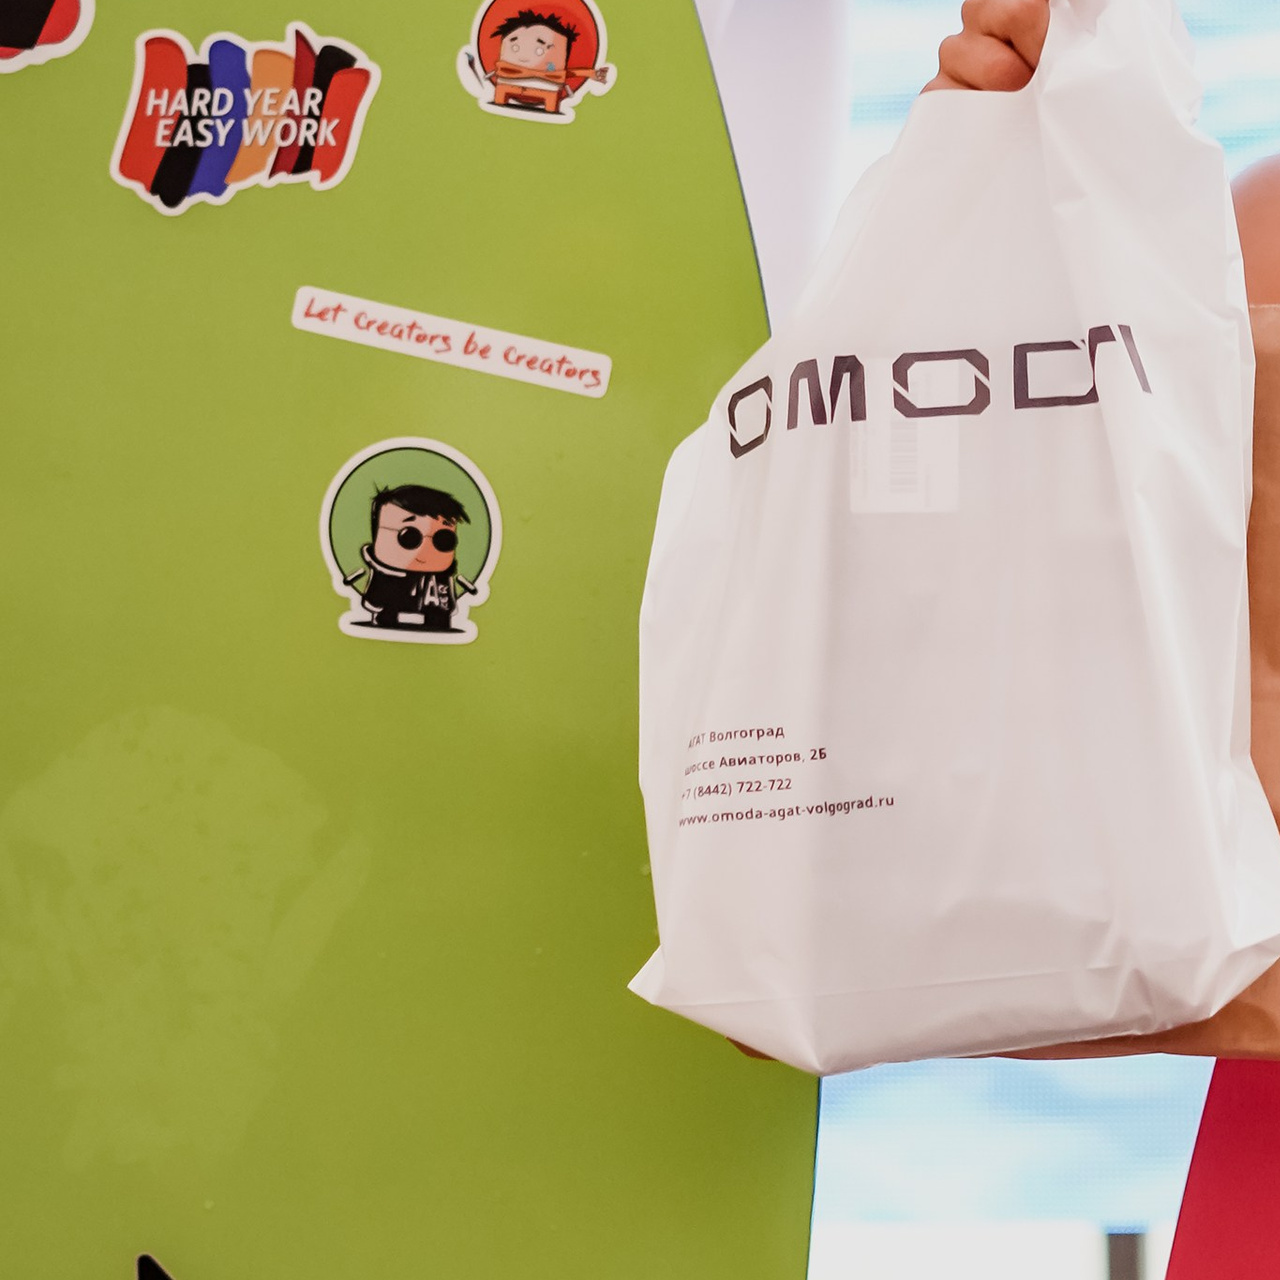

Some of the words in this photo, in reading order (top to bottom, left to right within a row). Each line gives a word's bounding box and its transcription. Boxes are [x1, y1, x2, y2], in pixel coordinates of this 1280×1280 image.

[146, 87, 234, 116] HARD
[243, 87, 323, 116] YEAR
[155, 118, 235, 148] EASY
[242, 118, 340, 148] WORK
[304, 297, 346, 324] Let
[463, 331, 491, 360] be
[709, 726, 786, 743] Волгоград
[719, 751, 806, 768] Авиаторов,
[809, 748, 828, 761] 2Б
[694, 783, 733, 799] (8442)
[736, 778, 793, 794] 722-722
[678, 796, 895, 827] www.omoda-agat-volgograd.ru
